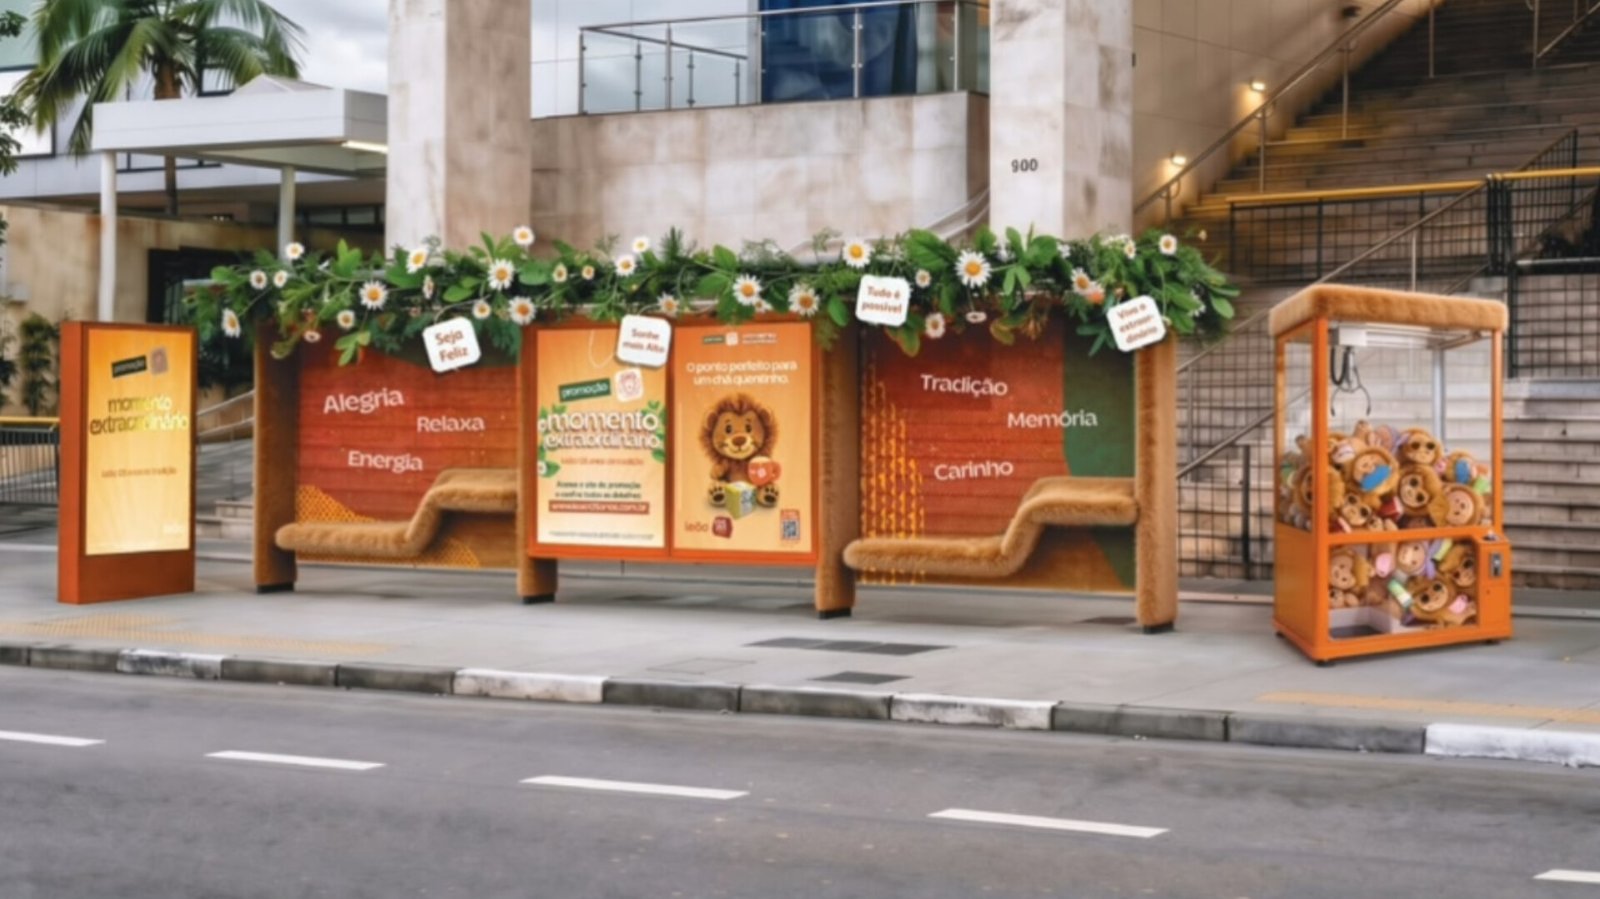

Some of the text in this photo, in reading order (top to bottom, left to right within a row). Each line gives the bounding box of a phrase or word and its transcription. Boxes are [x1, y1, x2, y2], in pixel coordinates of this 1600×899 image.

[1011, 158, 1038, 173] 900
[435, 329, 463, 346] Seja
[631, 328, 659, 340] Sonhe
[439, 347, 468, 363] Feliz
[696, 362, 728, 374] ponto
[729, 360, 770, 374] perfeito
[772, 360, 798, 374] para
[693, 376, 712, 385] um
[712, 374, 732, 385] chá
[920, 374, 1008, 398] Tradição
[562, 383, 609, 399] promoção
[323, 387, 405, 415] Alegria
[416, 415, 485, 433] Relaxa
[547, 410, 659, 433] momento
[1007, 409, 1098, 428] Memória
[348, 450, 424, 474] Energia
[934, 460, 1014, 481] Carinho
